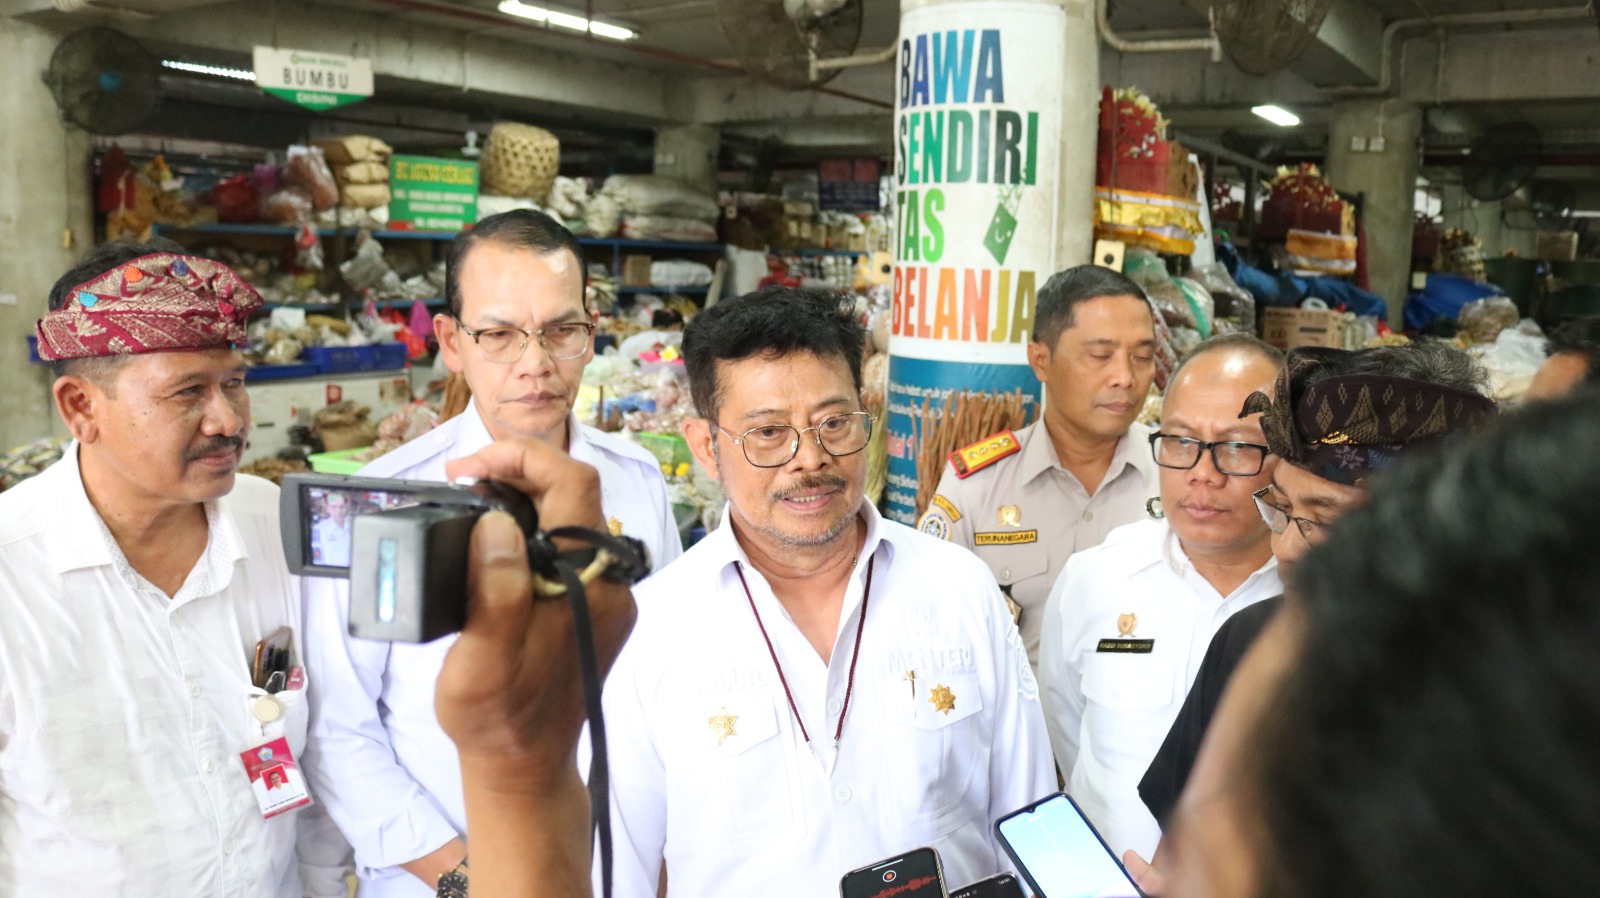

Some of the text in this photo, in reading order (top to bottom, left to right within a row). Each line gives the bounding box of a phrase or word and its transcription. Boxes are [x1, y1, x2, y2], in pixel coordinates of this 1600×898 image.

[283, 67, 349, 89] BUMBU
[900, 29, 1004, 109] BAWA
[898, 109, 1038, 186] SENDIRI
[897, 188, 944, 263] TAS
[892, 265, 1036, 343] BELANJA
[976, 533, 1035, 543] TERUNANEGARA
